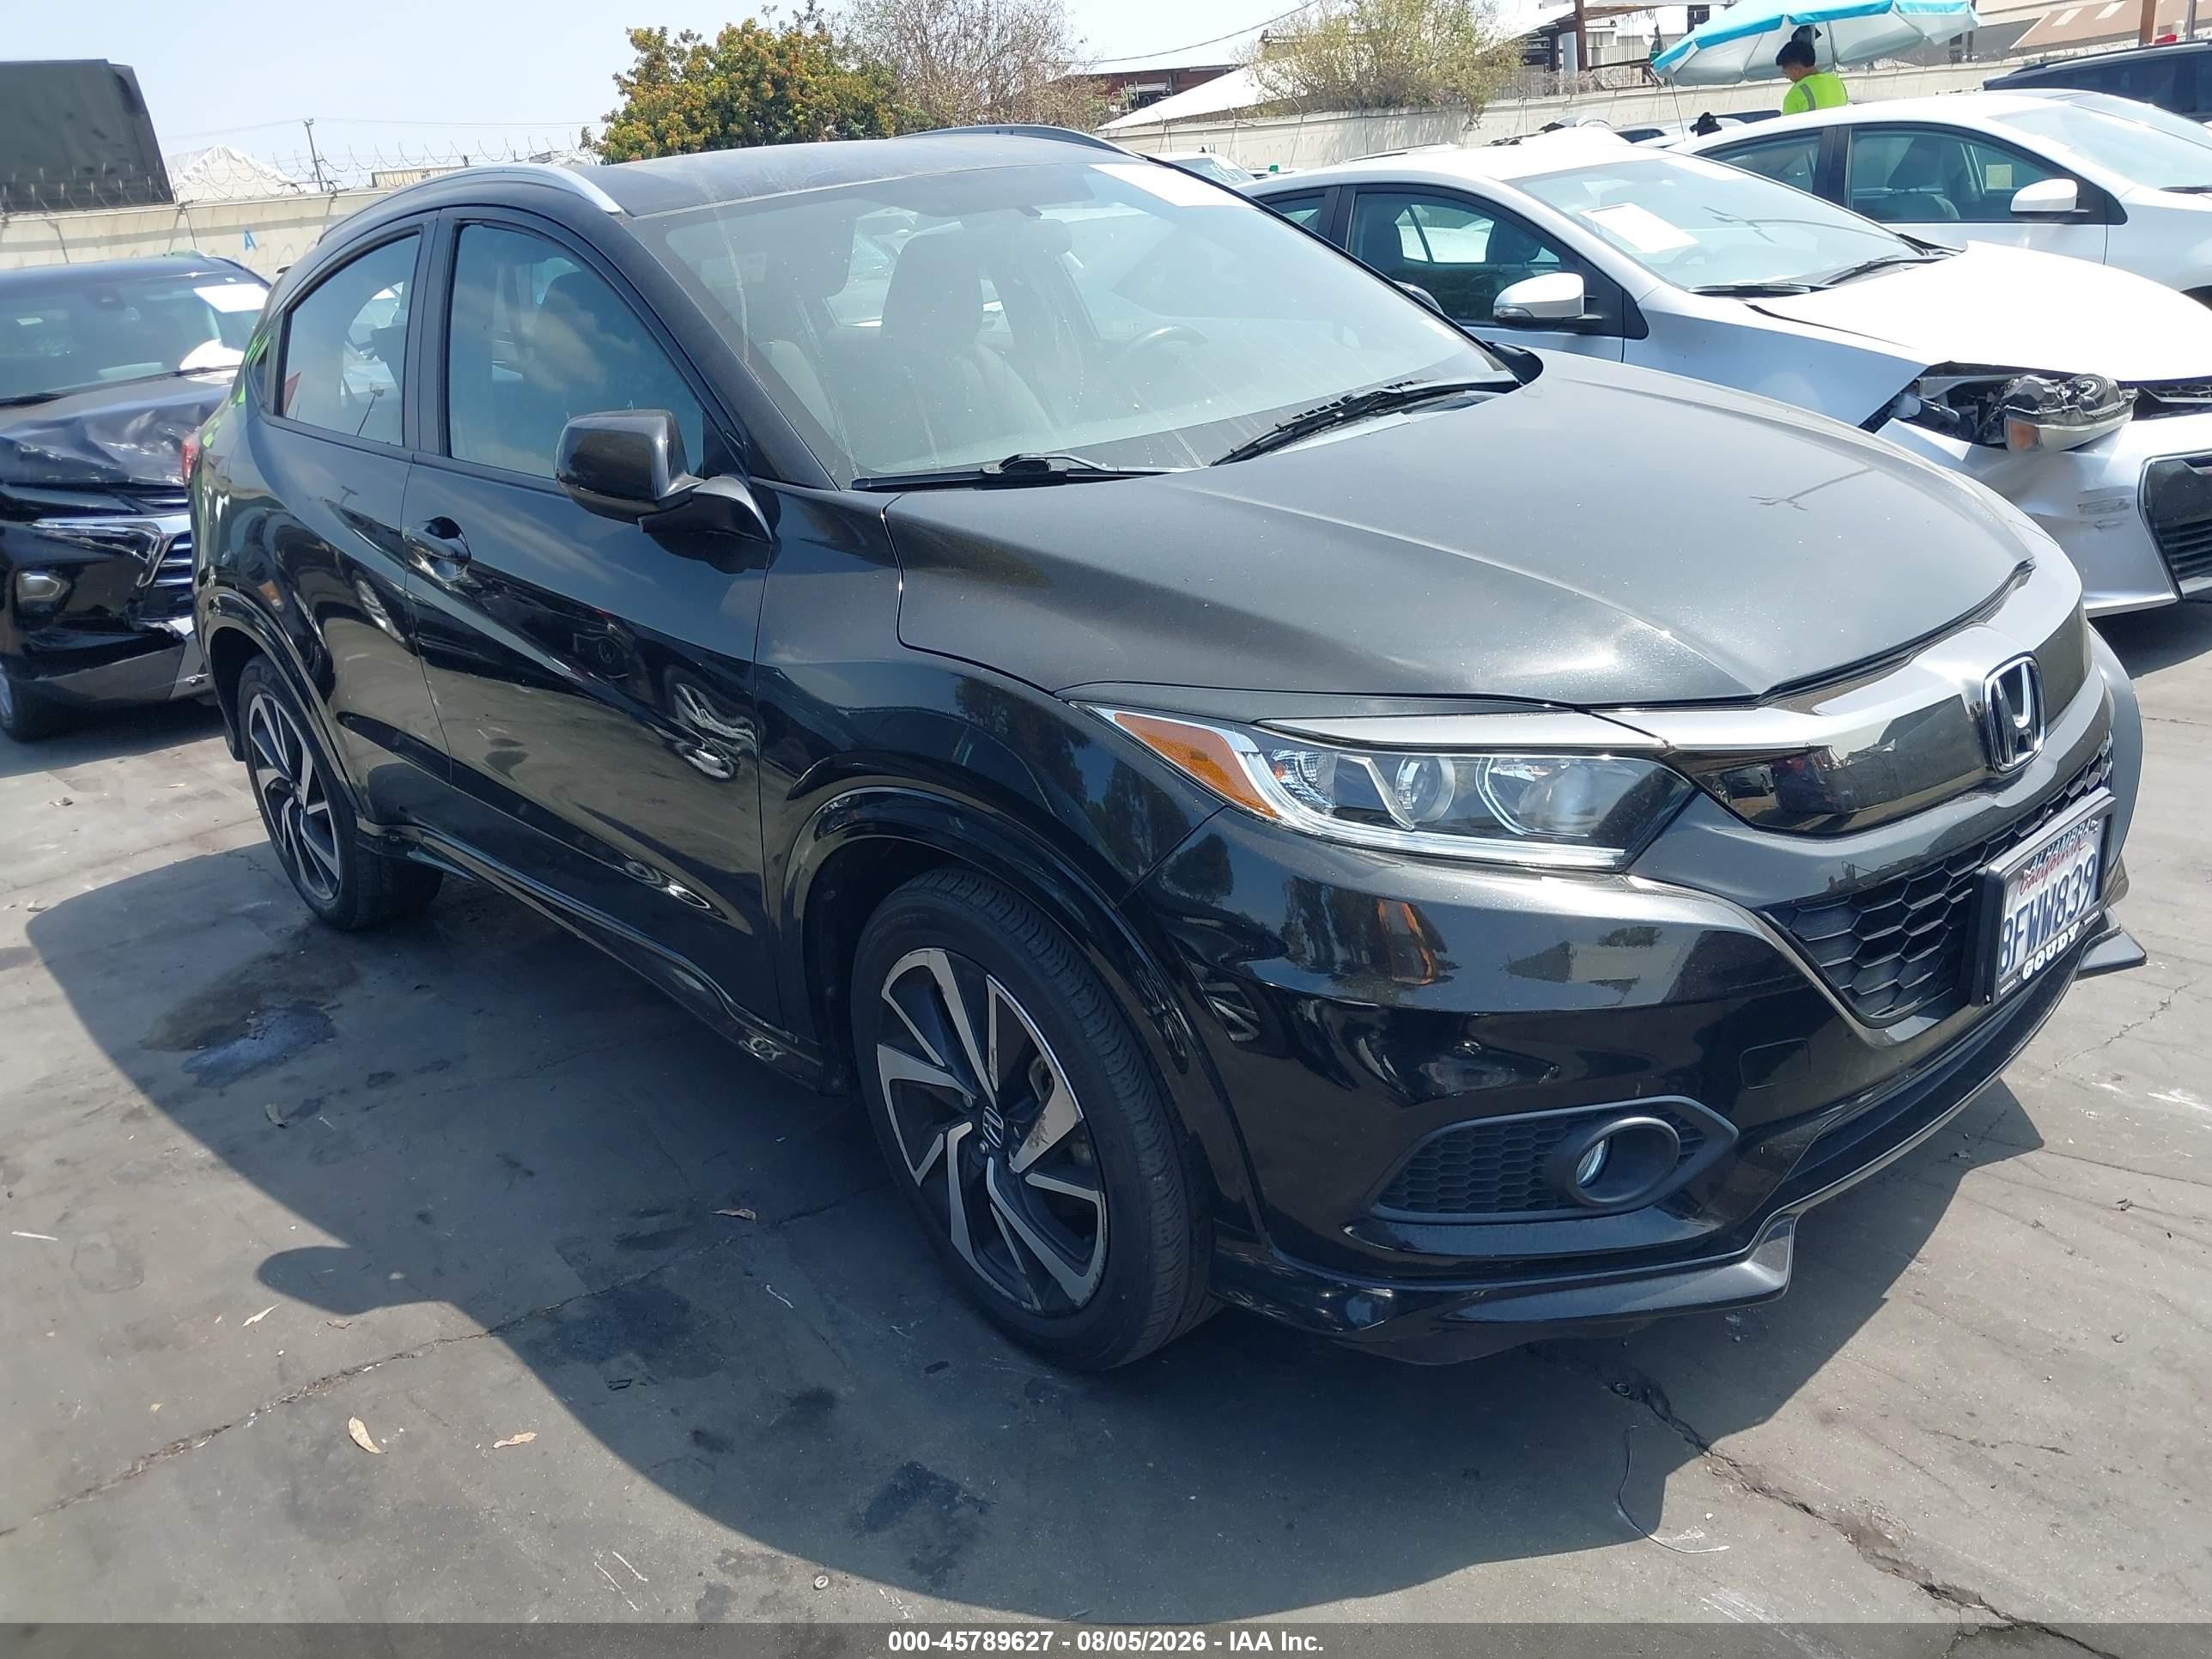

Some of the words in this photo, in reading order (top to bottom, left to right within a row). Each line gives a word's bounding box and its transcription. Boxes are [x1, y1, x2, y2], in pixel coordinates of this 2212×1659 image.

[2029, 817, 2092, 872] ALHAMBRA
[1999, 853, 2096, 976] 8FWW839
[2022, 921, 2081, 980] GOUDY
